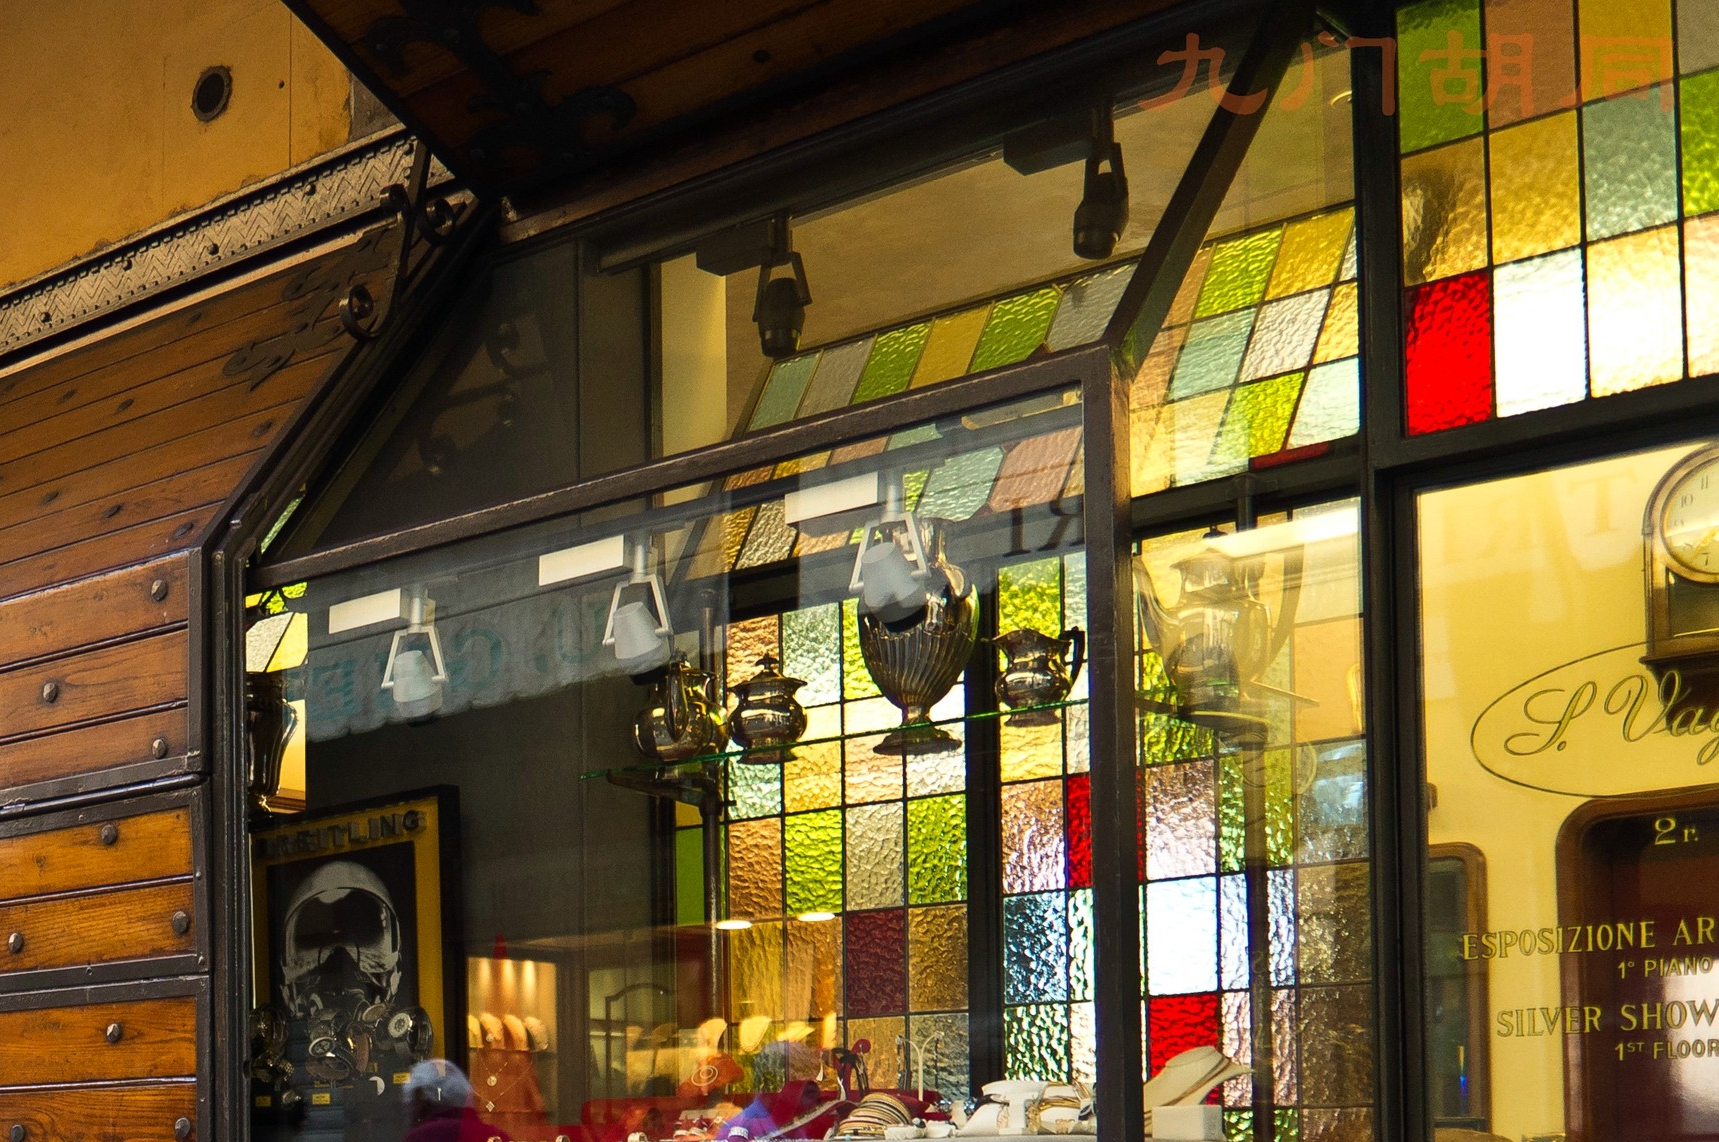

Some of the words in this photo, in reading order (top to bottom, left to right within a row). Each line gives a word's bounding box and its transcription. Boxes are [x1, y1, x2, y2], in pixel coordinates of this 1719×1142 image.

[1655, 817, 1676, 846] 2
[1463, 920, 1656, 961] ESPOSIZIONE
[1643, 955, 1714, 978] PIANO
[1496, 1006, 1602, 1038] SILVER
[1619, 1000, 1719, 1032] SHOW
[1652, 1037, 1719, 1061] FLOOR
